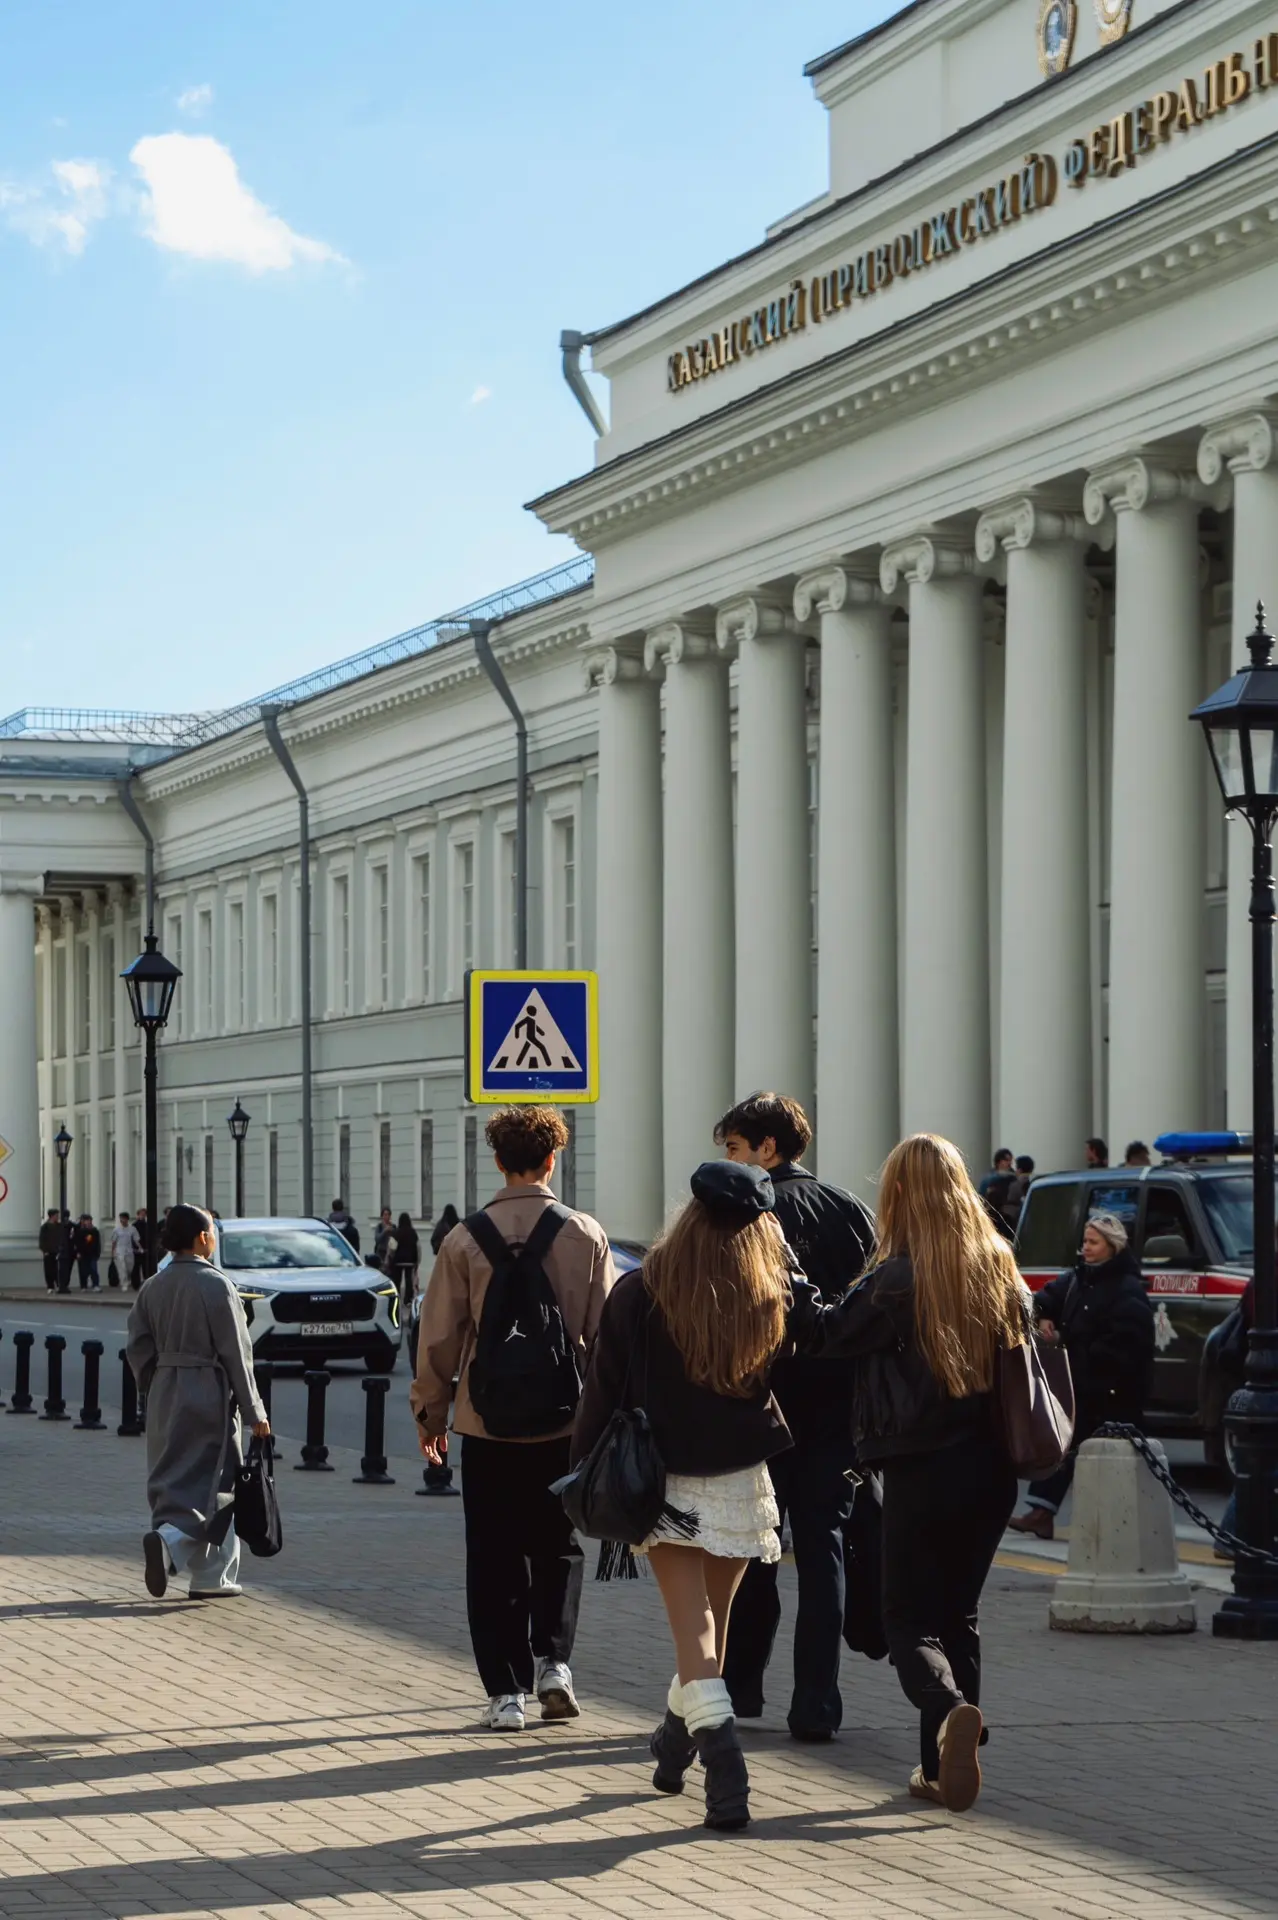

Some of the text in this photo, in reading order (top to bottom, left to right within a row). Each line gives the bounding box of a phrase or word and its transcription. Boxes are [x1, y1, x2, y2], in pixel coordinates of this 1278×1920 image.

[668, 32, 1278, 391] КАЗАНСКИЙ (ПРИВОЛЖСКИЙ) ФЕДЕРАЛЬН
[1153, 1275, 1199, 1292] ПОЛИЦИЯ
